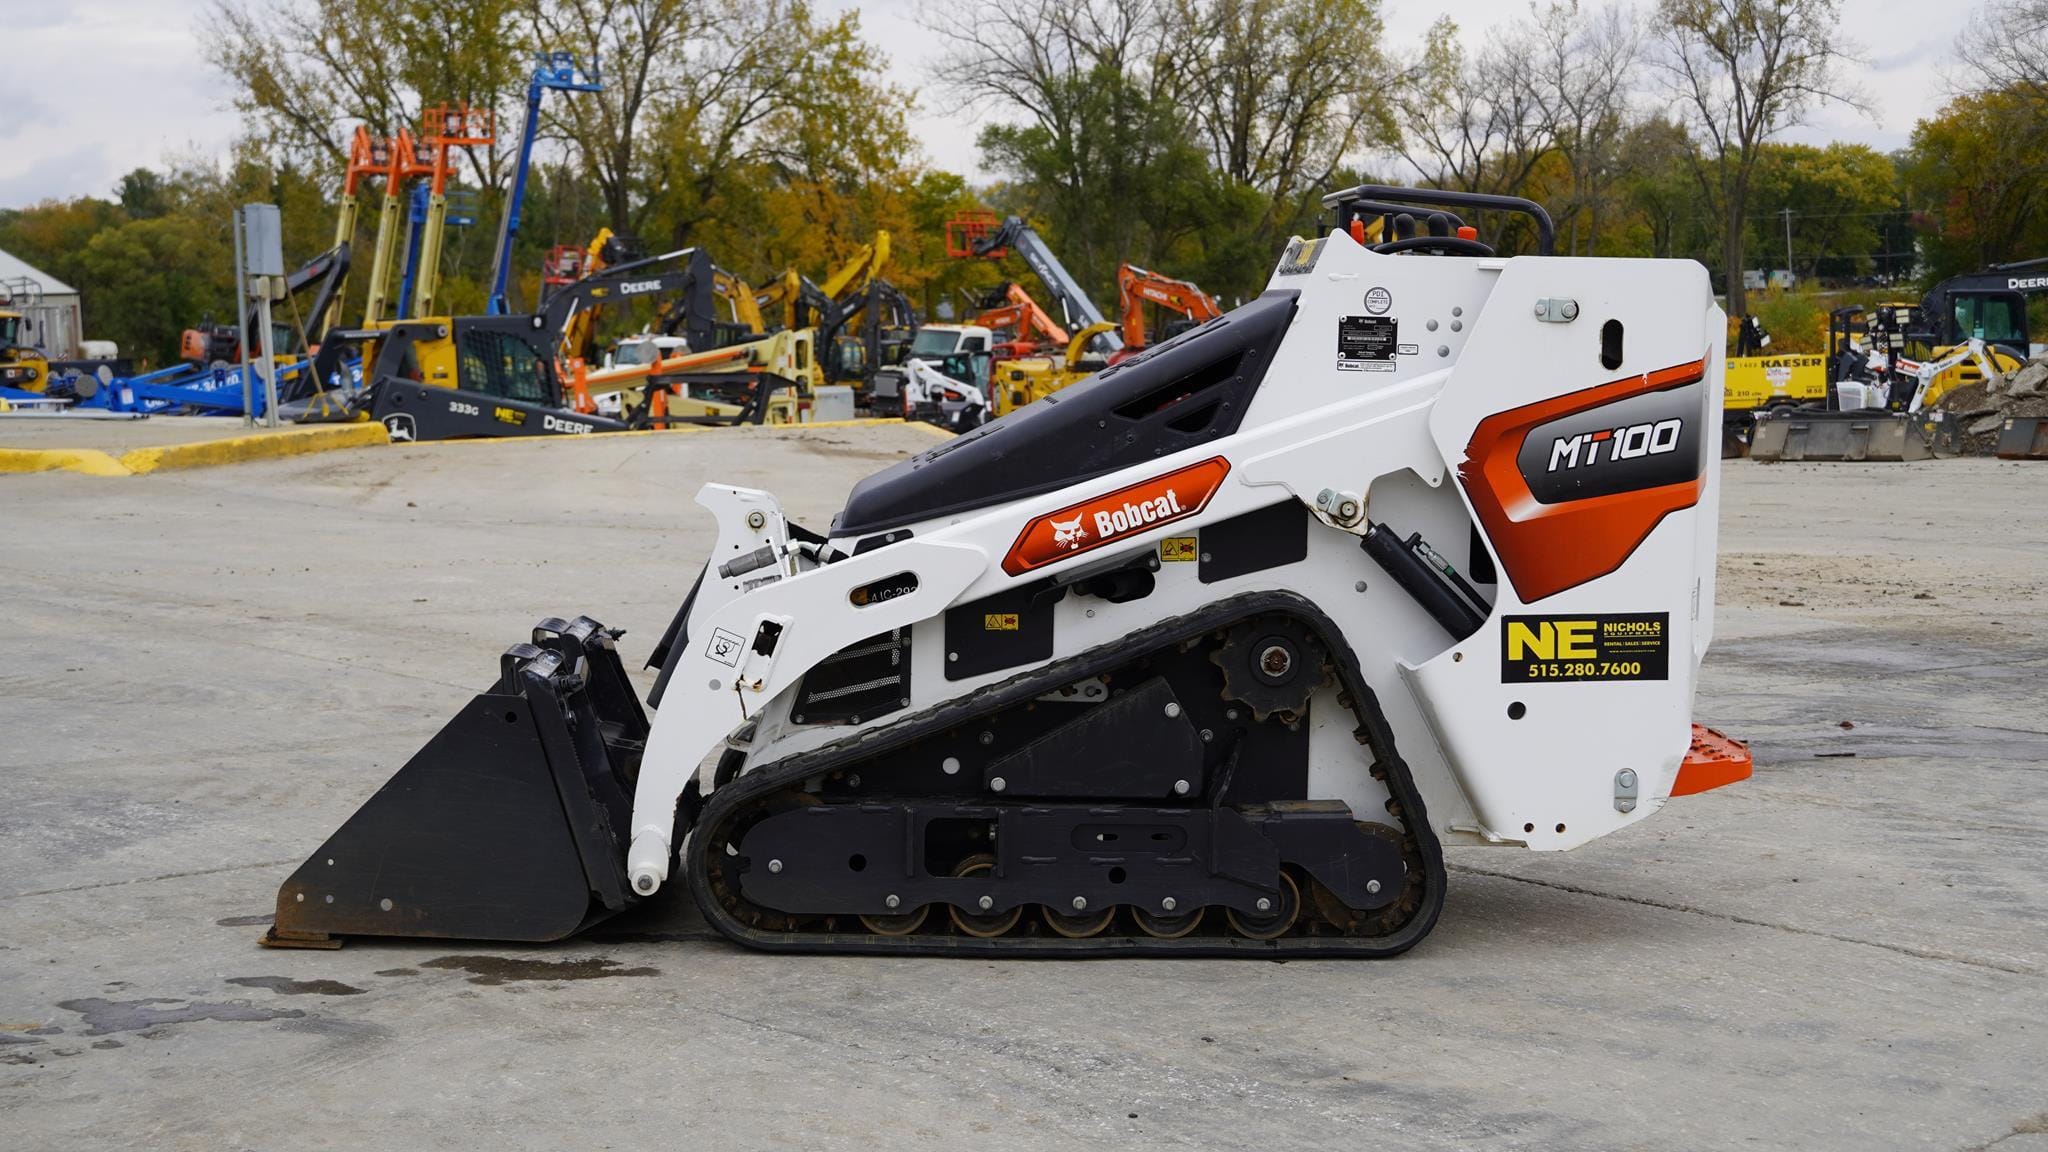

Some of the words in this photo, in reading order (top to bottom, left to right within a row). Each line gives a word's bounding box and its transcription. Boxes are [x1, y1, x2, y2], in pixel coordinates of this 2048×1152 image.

[620, 280, 662, 294] DEERE
[2007, 277, 2048, 289] DEER
[1761, 358, 1822, 368] KAESER
[449, 401, 479, 416] 333G
[543, 414, 594, 434] DEERE
[1548, 418, 1682, 472] MT100
[1093, 489, 1181, 539] Bobcat
[1507, 620, 1598, 661] NE
[1603, 621, 1661, 633] NICHOLS
[1528, 662, 1642, 678] 515.280.7600
